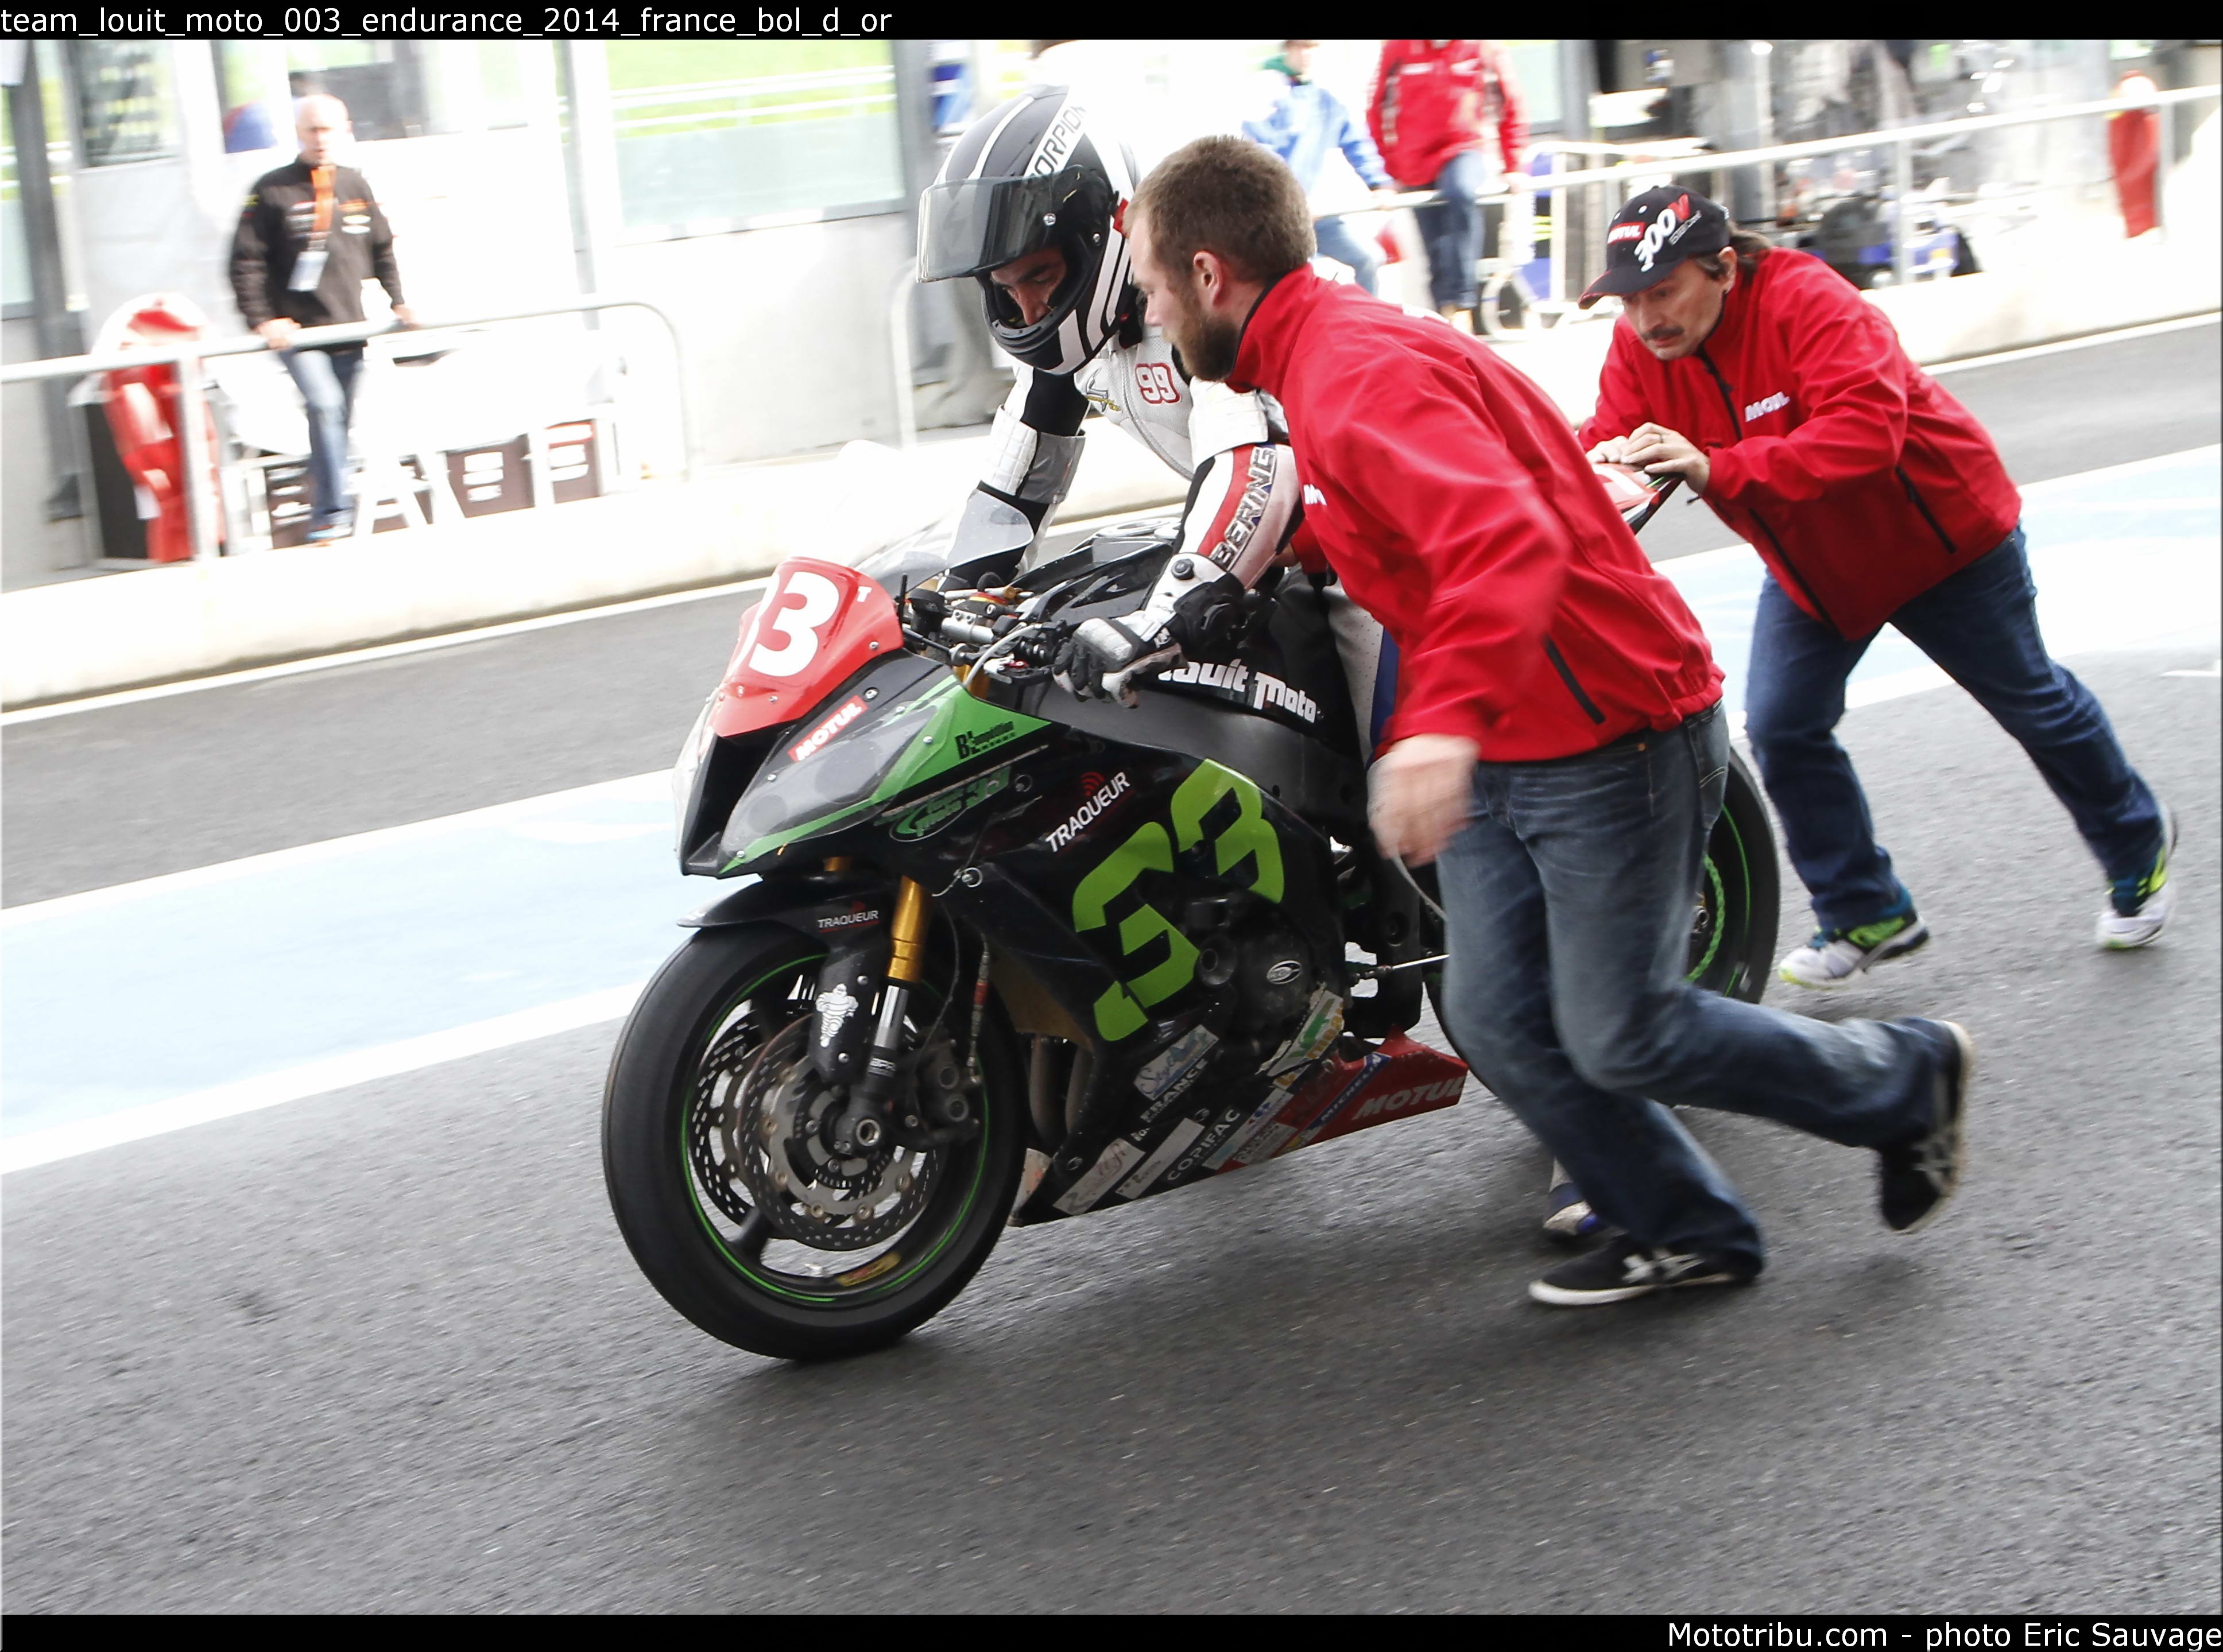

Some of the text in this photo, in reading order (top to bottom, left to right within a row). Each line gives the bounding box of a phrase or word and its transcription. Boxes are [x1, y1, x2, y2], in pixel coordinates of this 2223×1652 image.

[1135, 363, 1182, 404] 99
[1209, 446, 1276, 571] BERING
[795, 703, 862, 761] MOTUL
[1045, 771, 1130, 852] TRAQUEUR
[818, 910, 878, 928] TRAQUEUR
[1072, 759, 1285, 1041] 33
[1140, 1058, 1209, 1123] FRANCE
[1351, 1076, 1466, 1120] MOTUL
[1167, 1109, 1241, 1181] COPIFAC
